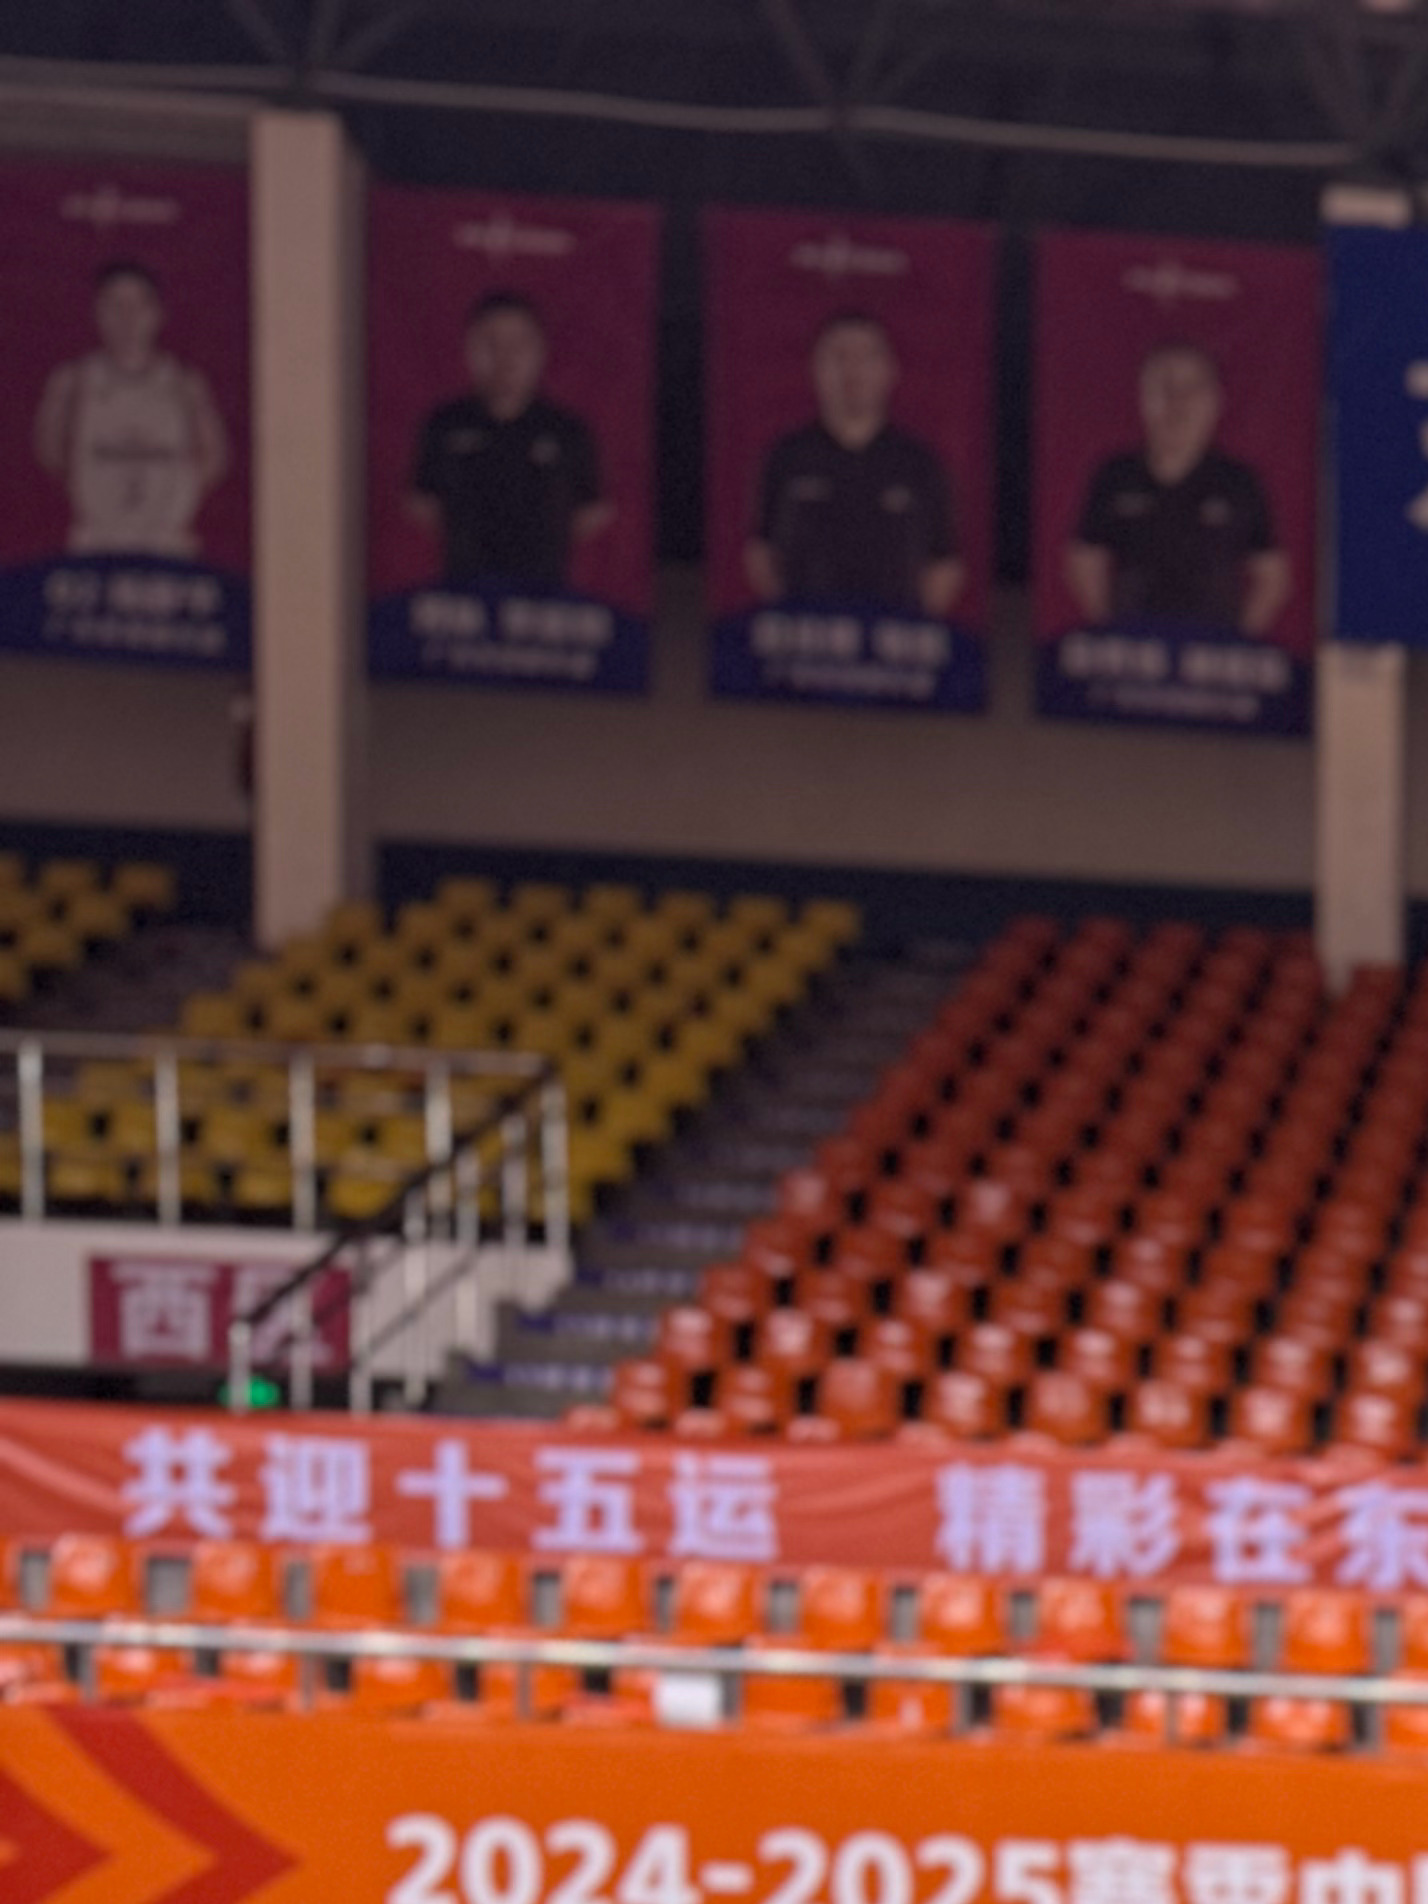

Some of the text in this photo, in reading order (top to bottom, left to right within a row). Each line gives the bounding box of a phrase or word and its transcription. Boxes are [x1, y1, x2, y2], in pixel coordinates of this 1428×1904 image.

[122, 1425, 780, 1562] 共迎十五运
